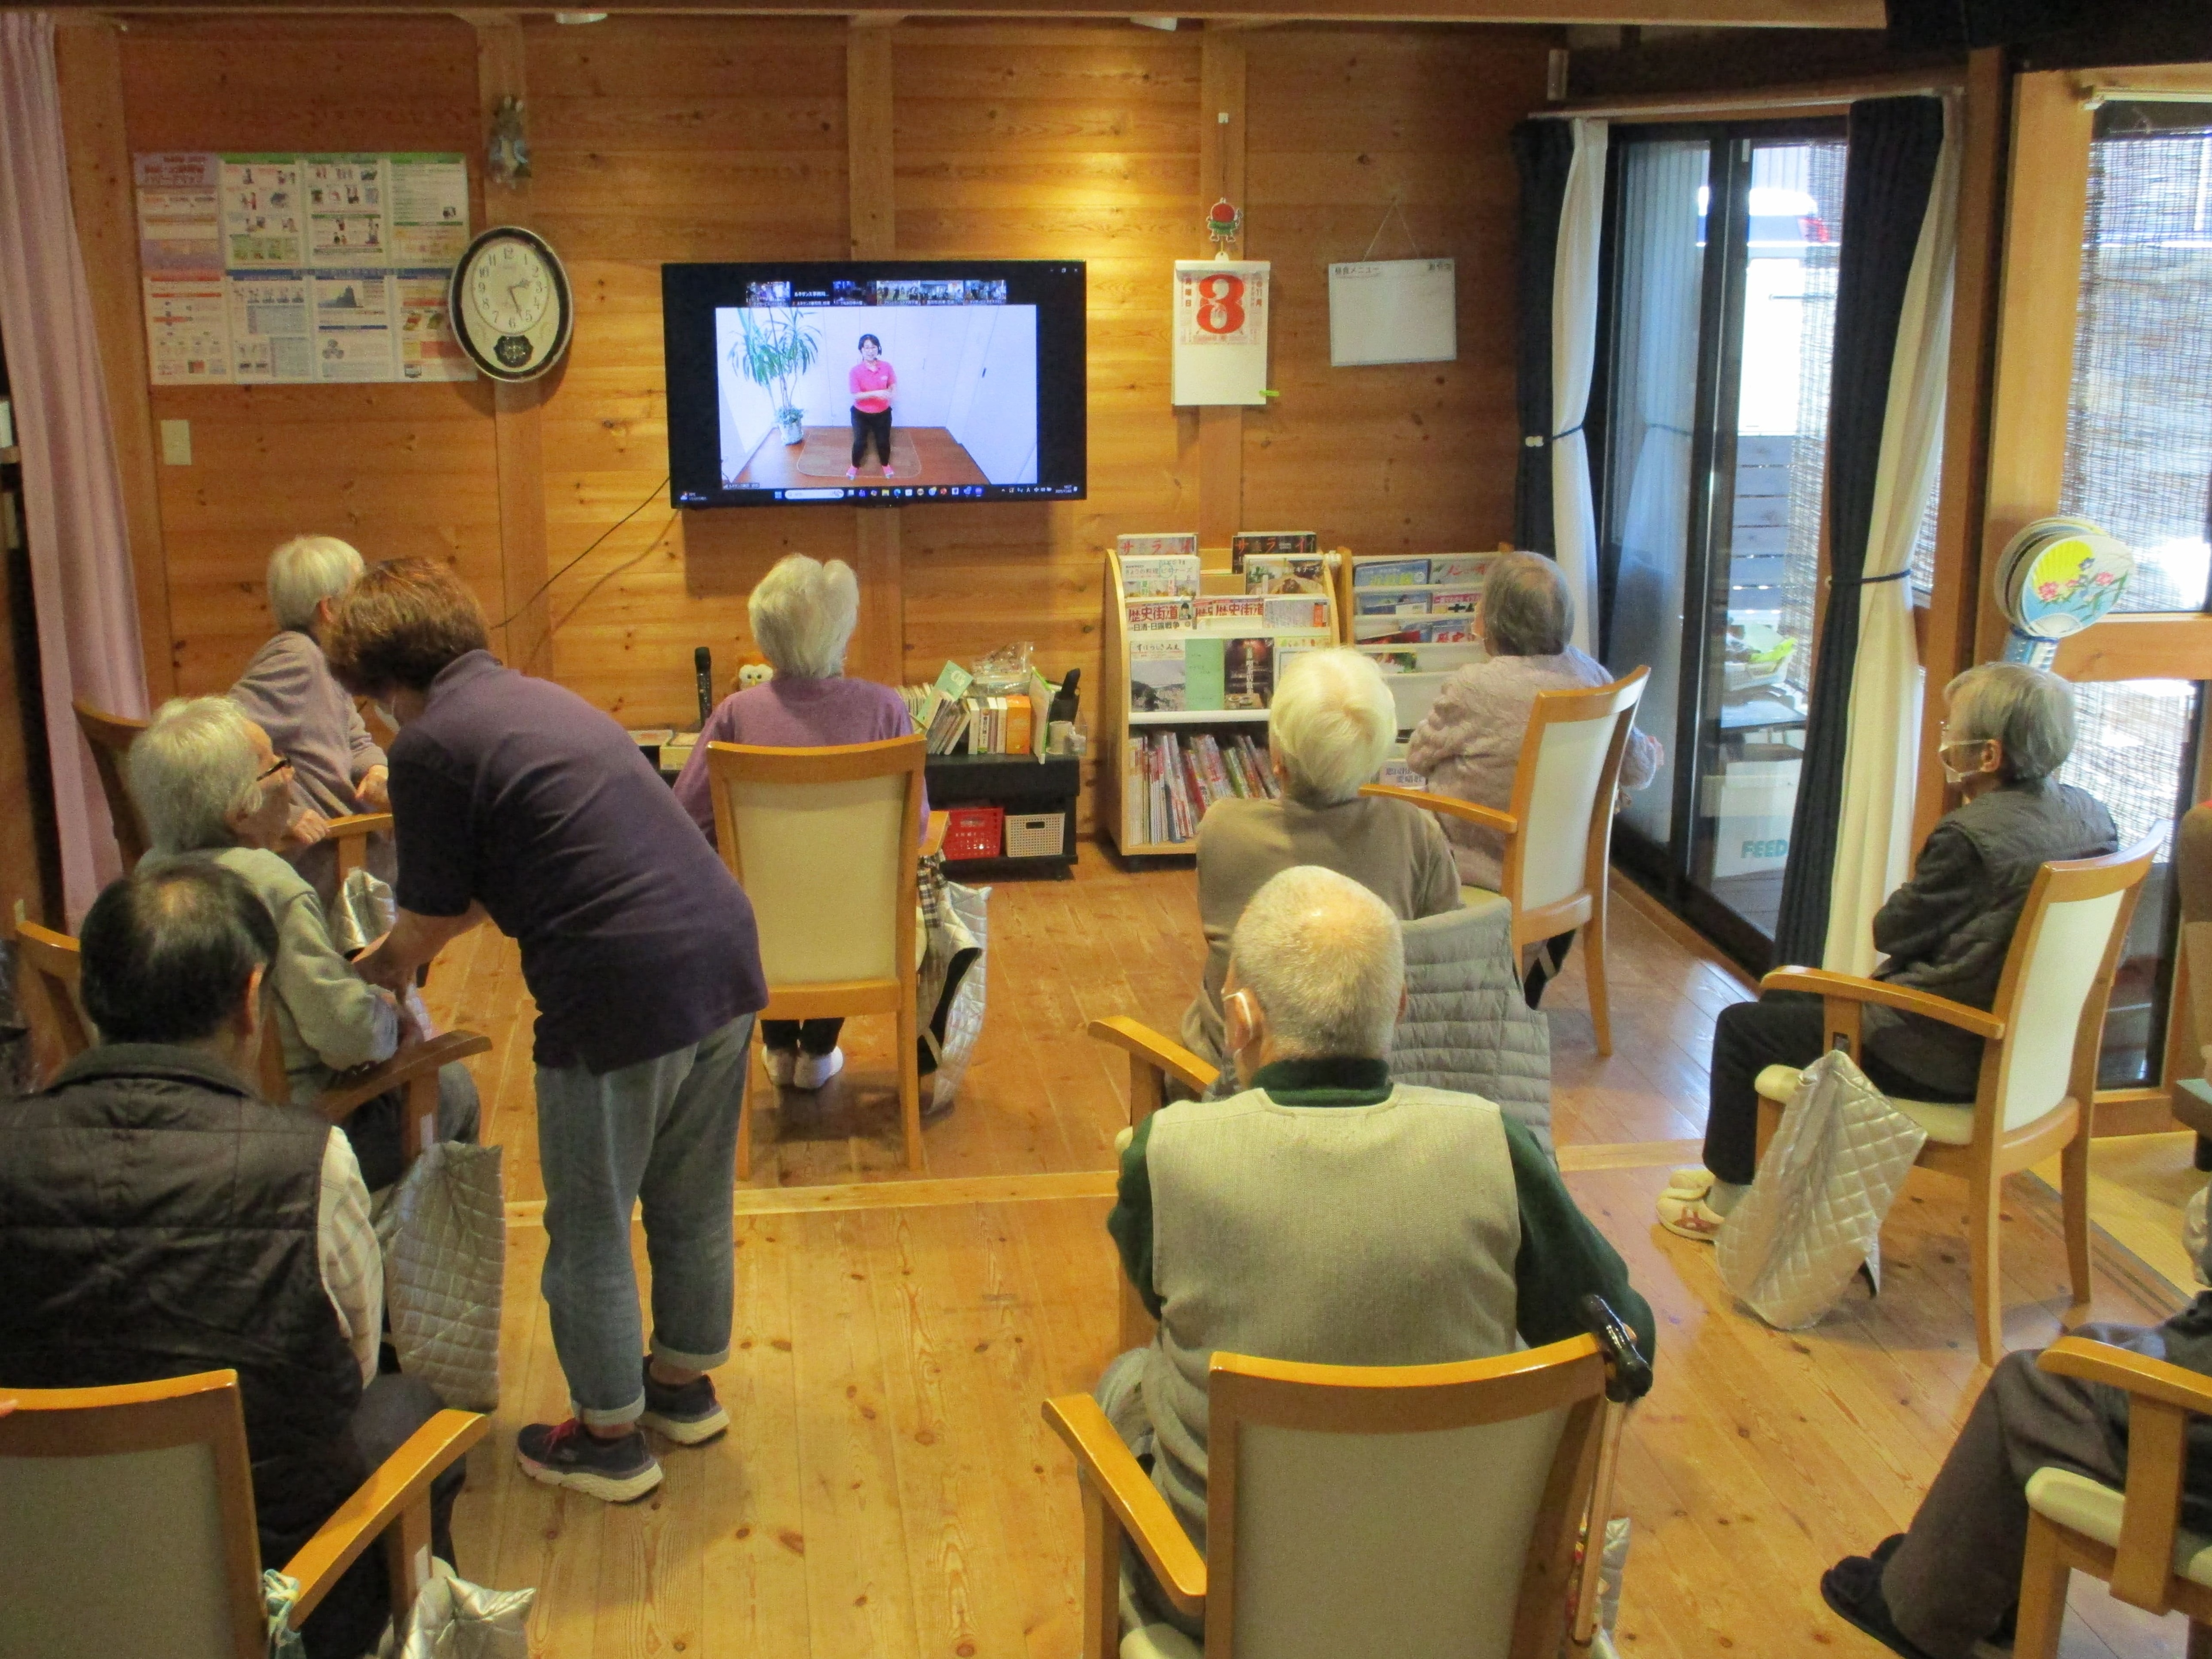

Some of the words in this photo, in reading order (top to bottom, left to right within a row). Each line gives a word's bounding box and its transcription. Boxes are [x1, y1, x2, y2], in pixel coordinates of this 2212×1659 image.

[504, 247, 513, 259] 12
[488, 254, 496, 266] 11
[524, 254, 528, 265] 1
[480, 267, 489, 277] 10
[532, 266, 539, 278] 2
[478, 283, 485, 294] 9
[535, 281, 542, 292] 3
[482, 299, 489, 310] 8
[534, 297, 540, 309] 4
[492, 311, 499, 323] 7
[508, 317, 515, 328] 6
[526, 310, 533, 323] 5
[1129, 605, 1179, 622] 歴史街道
